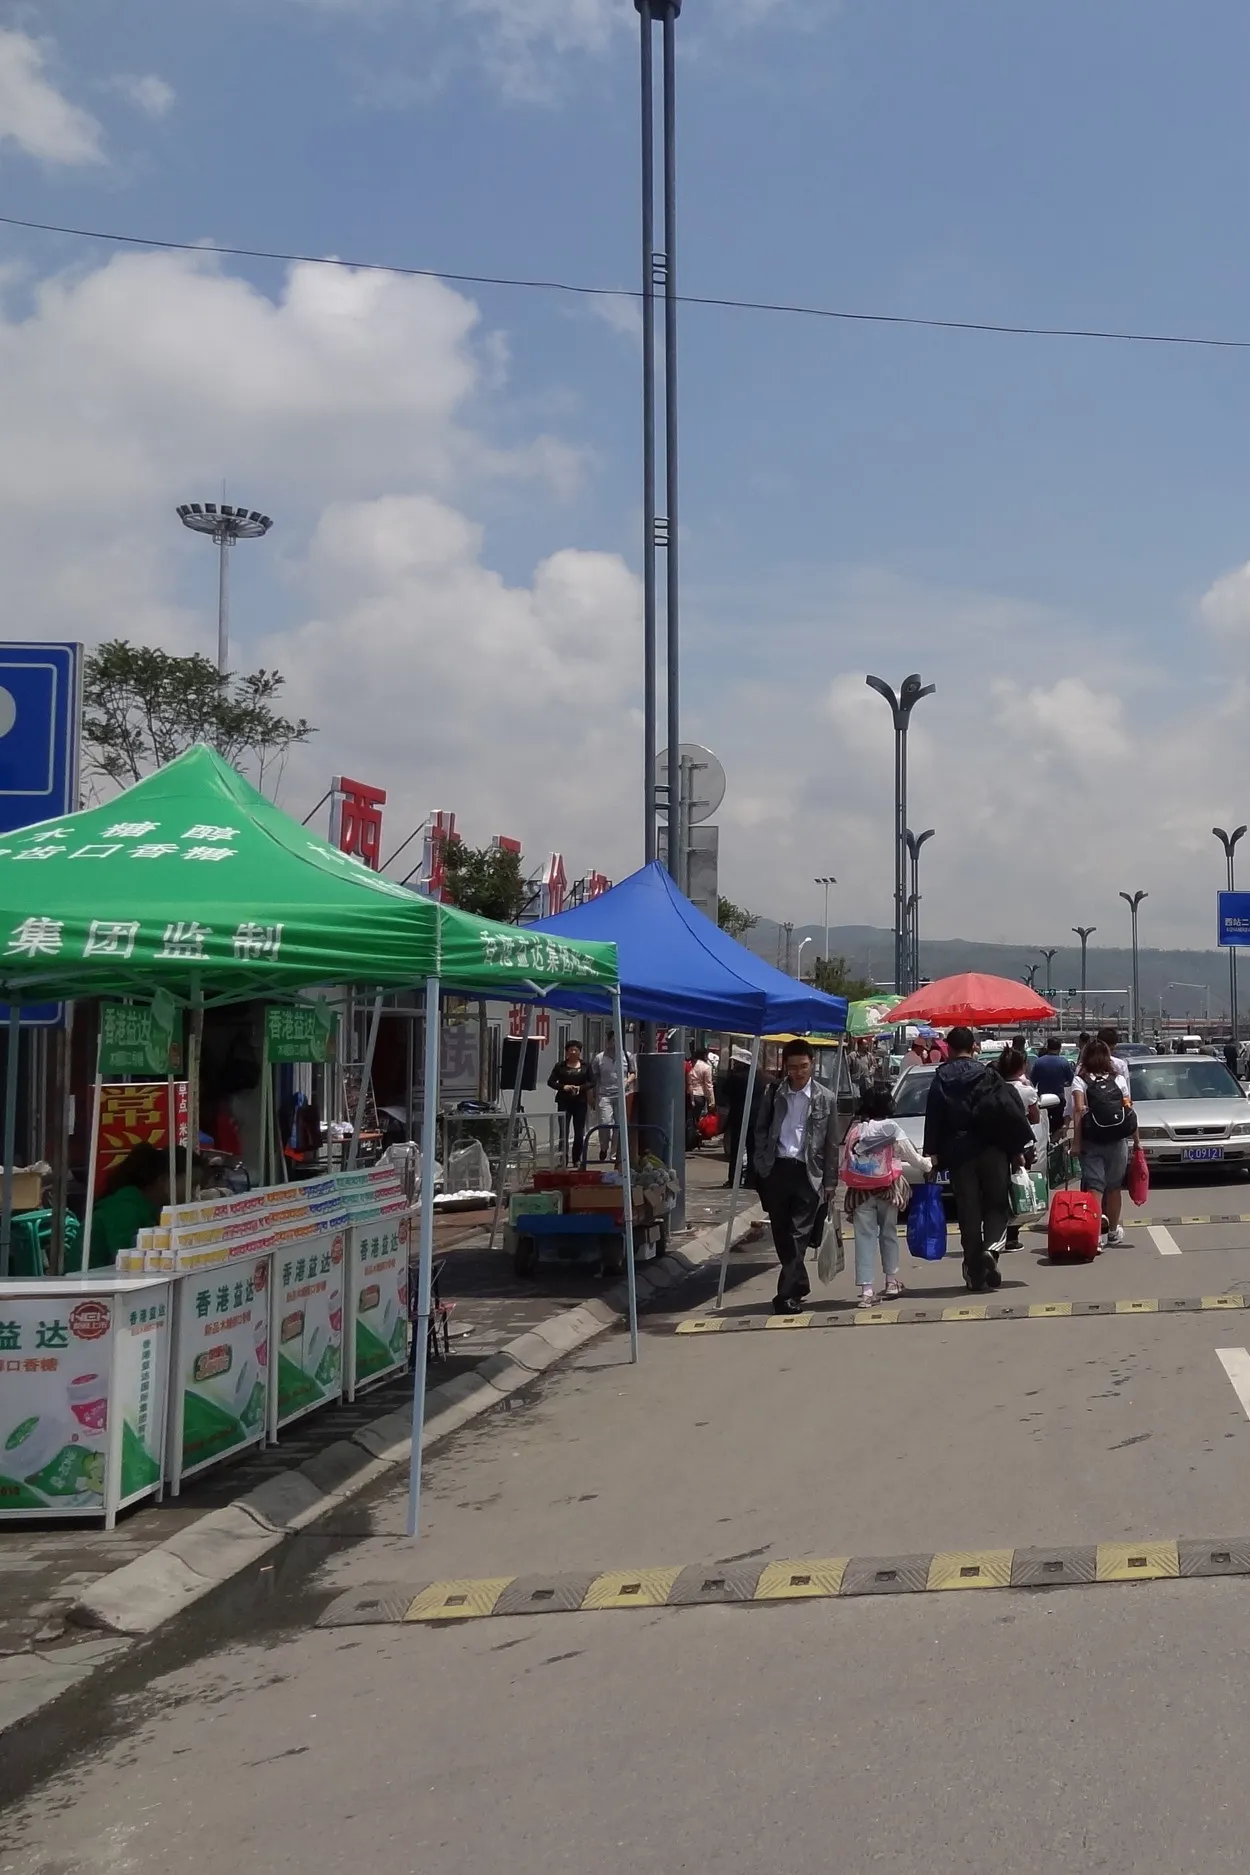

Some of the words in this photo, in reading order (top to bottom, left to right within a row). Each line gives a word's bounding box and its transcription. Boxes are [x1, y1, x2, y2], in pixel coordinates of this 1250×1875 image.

[0, 843, 239, 862] 齿口香糖
[2, 916, 285, 962] 集团监制
[104, 1008, 151, 1046] 香港益达
[268, 1010, 315, 1041] 香港益达
[359, 1231, 399, 1262] 香港益达
[282, 1251, 332, 1288] 香港益达
[195, 1277, 255, 1320] 香港益达
[0, 1319, 69, 1351] 益达
[0, 1357, 59, 1373] 口香糖
